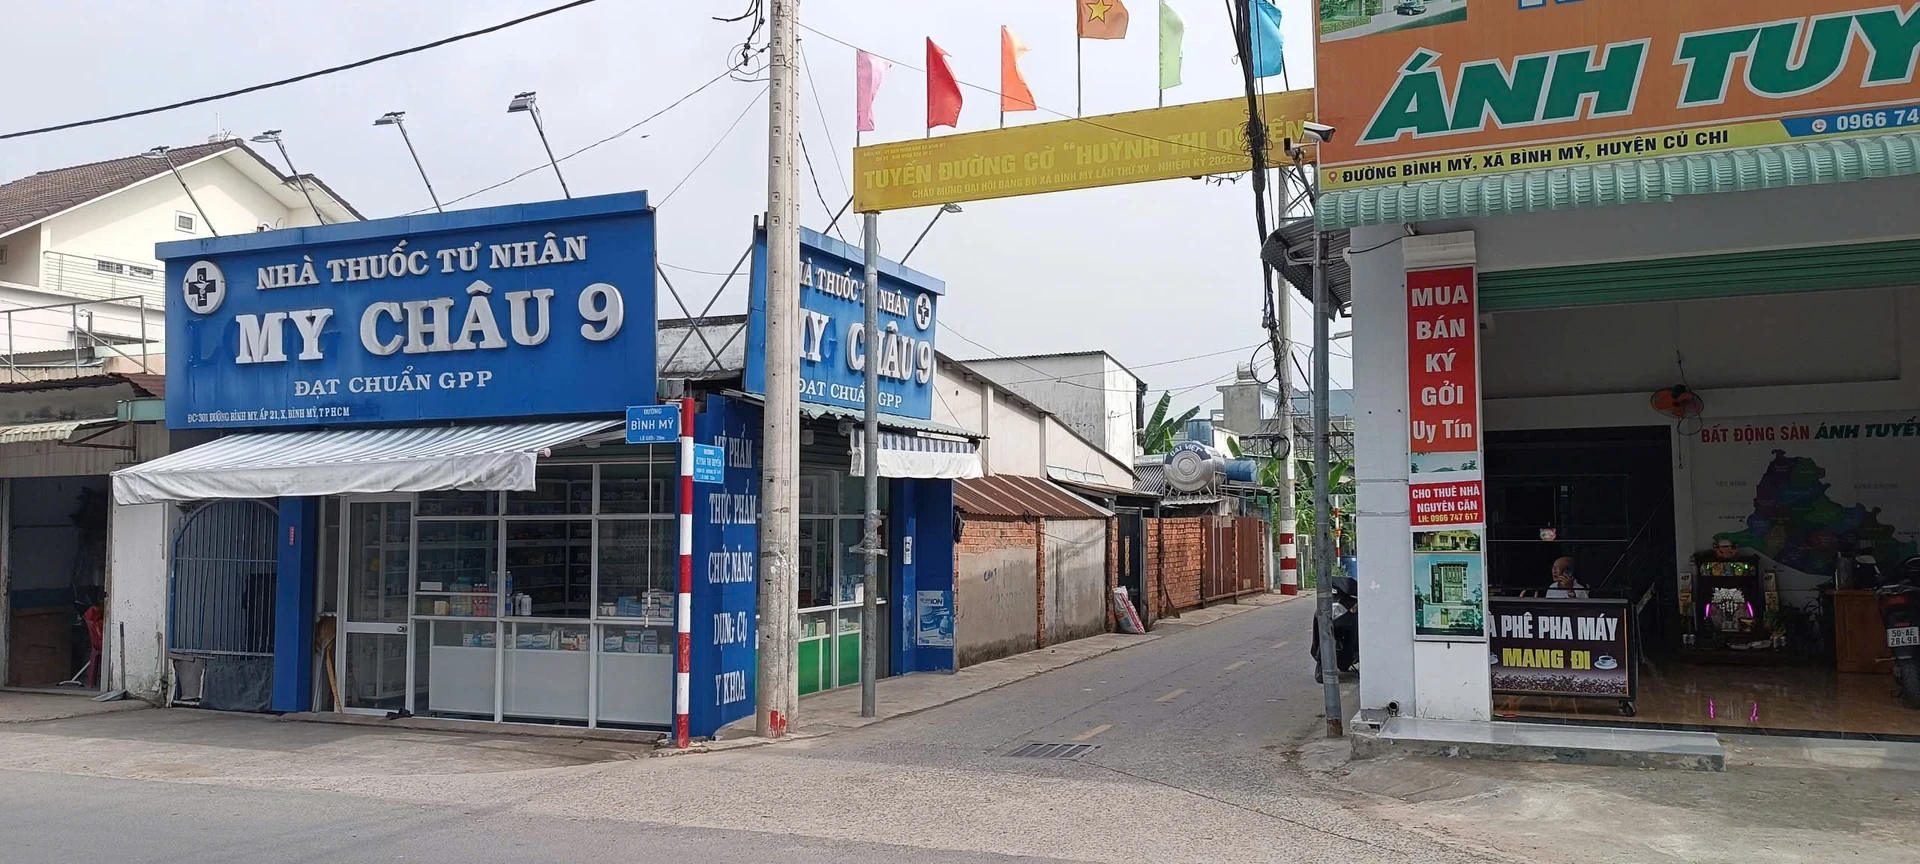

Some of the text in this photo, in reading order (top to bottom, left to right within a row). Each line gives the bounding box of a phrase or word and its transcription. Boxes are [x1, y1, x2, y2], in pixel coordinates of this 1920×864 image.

[1357, 38, 1651, 145] ÁNH
[1836, 112, 1887, 131] 0966
[864, 160, 931, 190] TUYẾN
[939, 155, 1016, 181] ĐƯỜNG
[1024, 146, 1055, 170] CỜ
[1167, 130, 1207, 157] THỊ
[1342, 129, 1728, 183] ĐƯỜNG BÌNH MỸ, XÃ BÌNH MỸ, HUYỆN CỦ CHI
[912, 187, 934, 199] CHÀO
[937, 184, 962, 196] MỪNG
[964, 182, 979, 194] ĐẠI
[982, 180, 996, 193] HỘI
[999, 177, 1022, 189] ĐẢNG
[1118, 163, 1136, 176] THỨ
[1138, 163, 1150, 173] XV
[1159, 158, 1191, 172] NHIỆM
[1194, 156, 1206, 168] KỲ
[1209, 155, 1233, 166] 2025
[257, 231, 587, 290] NHÀ THUỐC TƯ NHÂN
[816, 267, 859, 301] THUỐC
[877, 289, 910, 318] NHÂN
[1412, 285, 1468, 307] MUA
[360, 280, 555, 356] CHÂU
[578, 282, 625, 342] 9
[1416, 315, 1465, 339] BÁN
[916, 341, 932, 384] 9
[1425, 348, 1457, 372] KÝ
[294, 366, 493, 400] ĐẠT CHUẨN GPP
[799, 378, 827, 400] ĐẠT
[878, 391, 902, 409] GPP
[1421, 380, 1464, 407] GỞI
[288, 407, 304, 419] BÌNH
[631, 416, 674, 430] BÌNH MỸ
[729, 423, 752, 468] PHẨM
[1413, 416, 1472, 444] Uy Tín
[1701, 423, 1728, 443] BẤT
[1733, 424, 1775, 444] ĐỘNG
[1780, 422, 1810, 441] SẢN
[1814, 421, 1860, 440] ÁNH
[709, 479, 756, 532] THỰC PHẨM
[1412, 484, 1480, 499] CHO THUÊ NHÀ
[1417, 498, 1478, 513] NGUYÊN CĂN
[1418, 512, 1478, 523] LH: 0966 747 617
[708, 543, 753, 584] CHỨC NĂNG
[737, 611, 748, 648] CỤ
[1501, 611, 1533, 639] PHÊ
[1538, 615, 1573, 640] PHA
[1577, 613, 1618, 641] MÁY
[1502, 648, 1591, 670] MANG ĐI
[715, 669, 746, 706] Y KHOA
